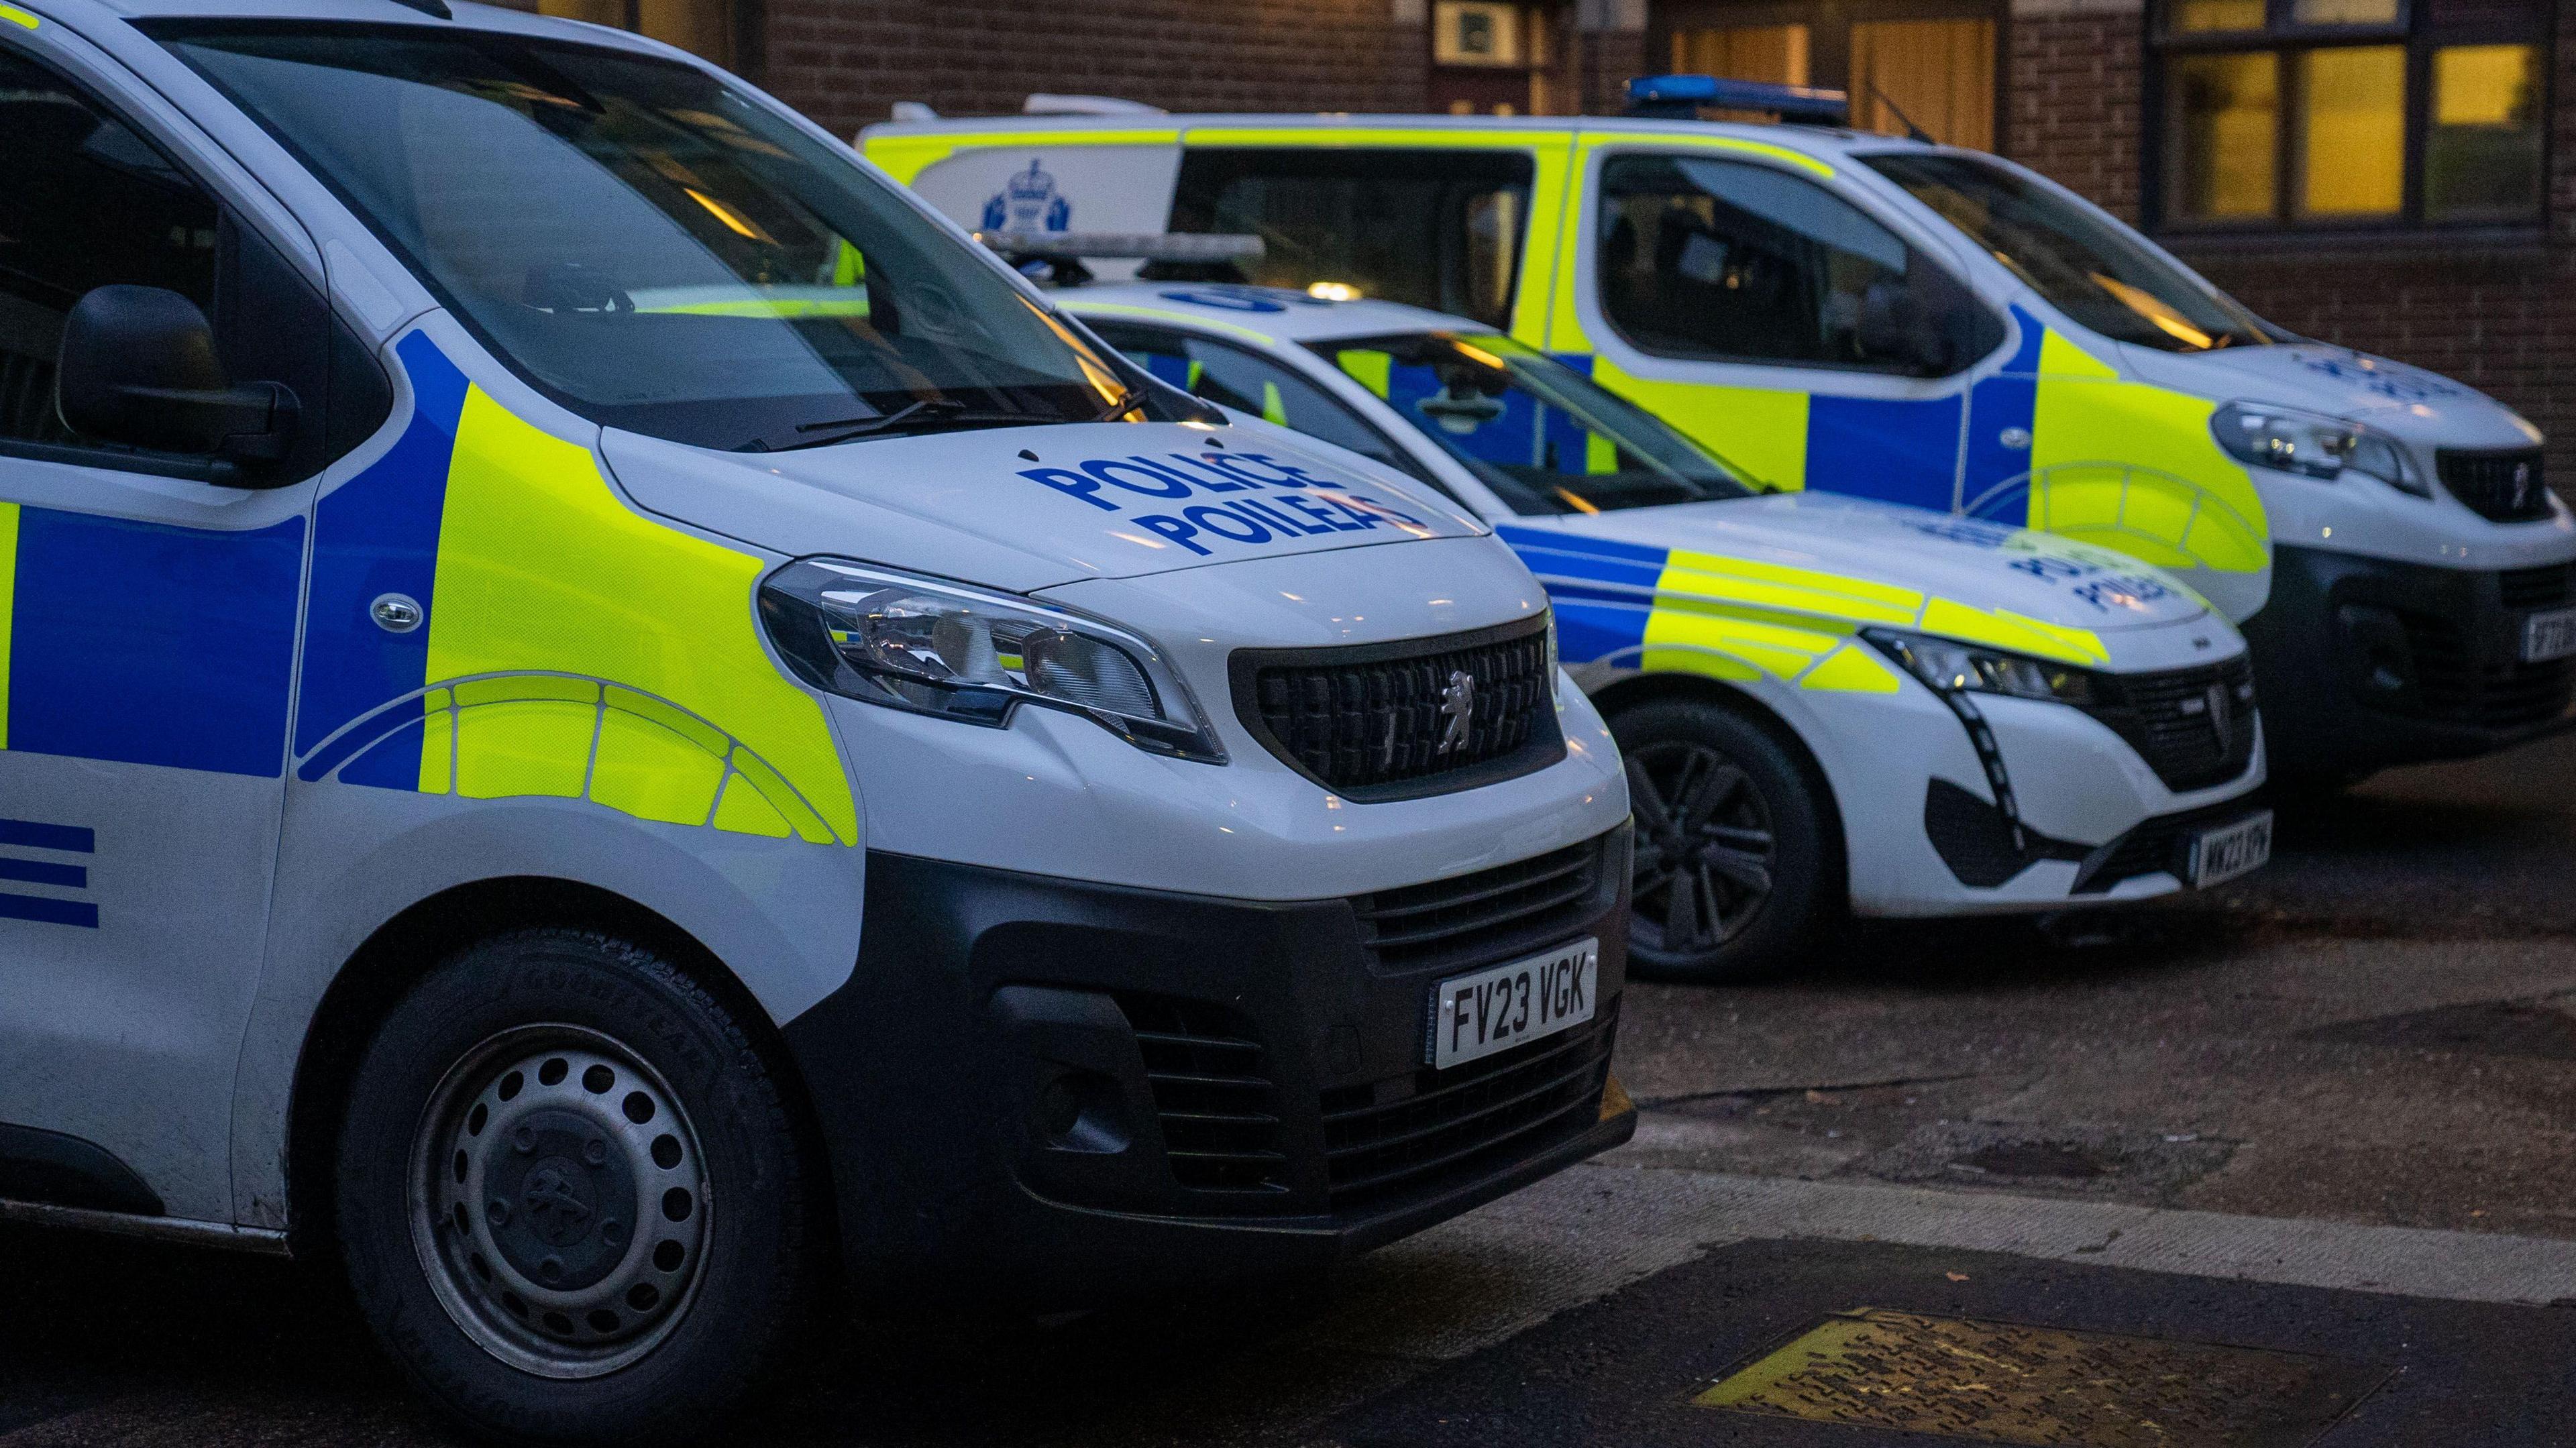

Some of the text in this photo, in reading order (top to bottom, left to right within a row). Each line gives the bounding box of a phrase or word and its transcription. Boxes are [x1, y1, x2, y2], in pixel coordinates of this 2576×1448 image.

[1016, 452, 1347, 511] POLICE
[1130, 495, 1430, 556] POILEAS
[1452, 952, 1587, 1053] FV23 VGK
